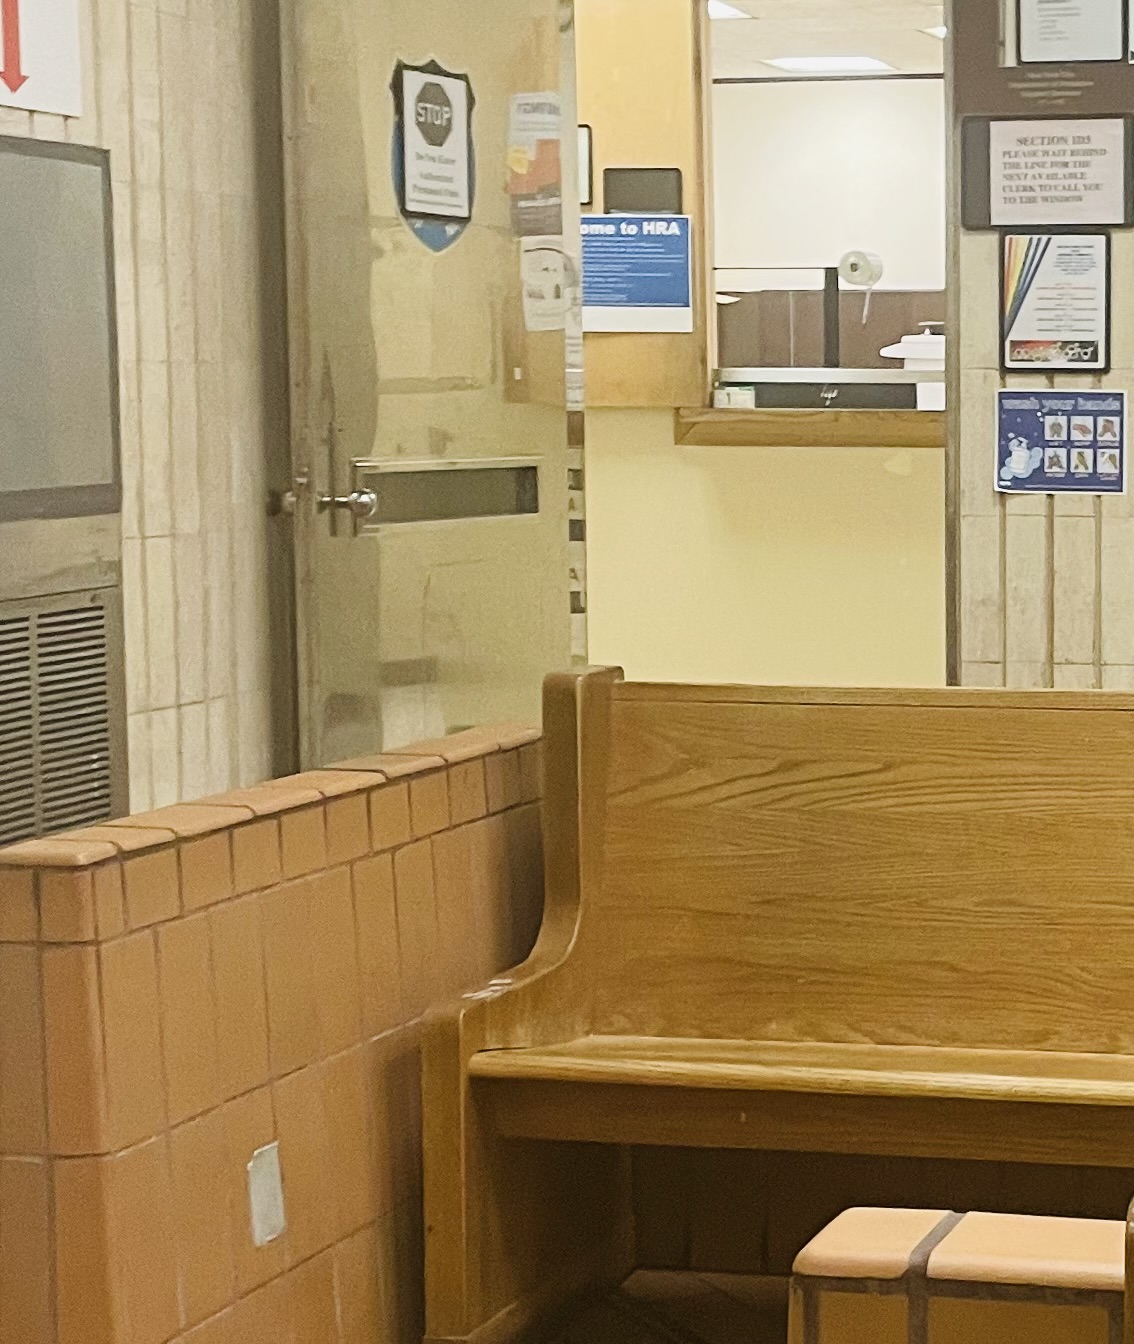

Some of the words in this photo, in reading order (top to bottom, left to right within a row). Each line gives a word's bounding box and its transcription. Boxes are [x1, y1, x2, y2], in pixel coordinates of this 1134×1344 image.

[416, 102, 451, 127] STOP
[1016, 136, 1070, 146] SECTION
[620, 221, 639, 235] to
[642, 221, 680, 236] HRA
